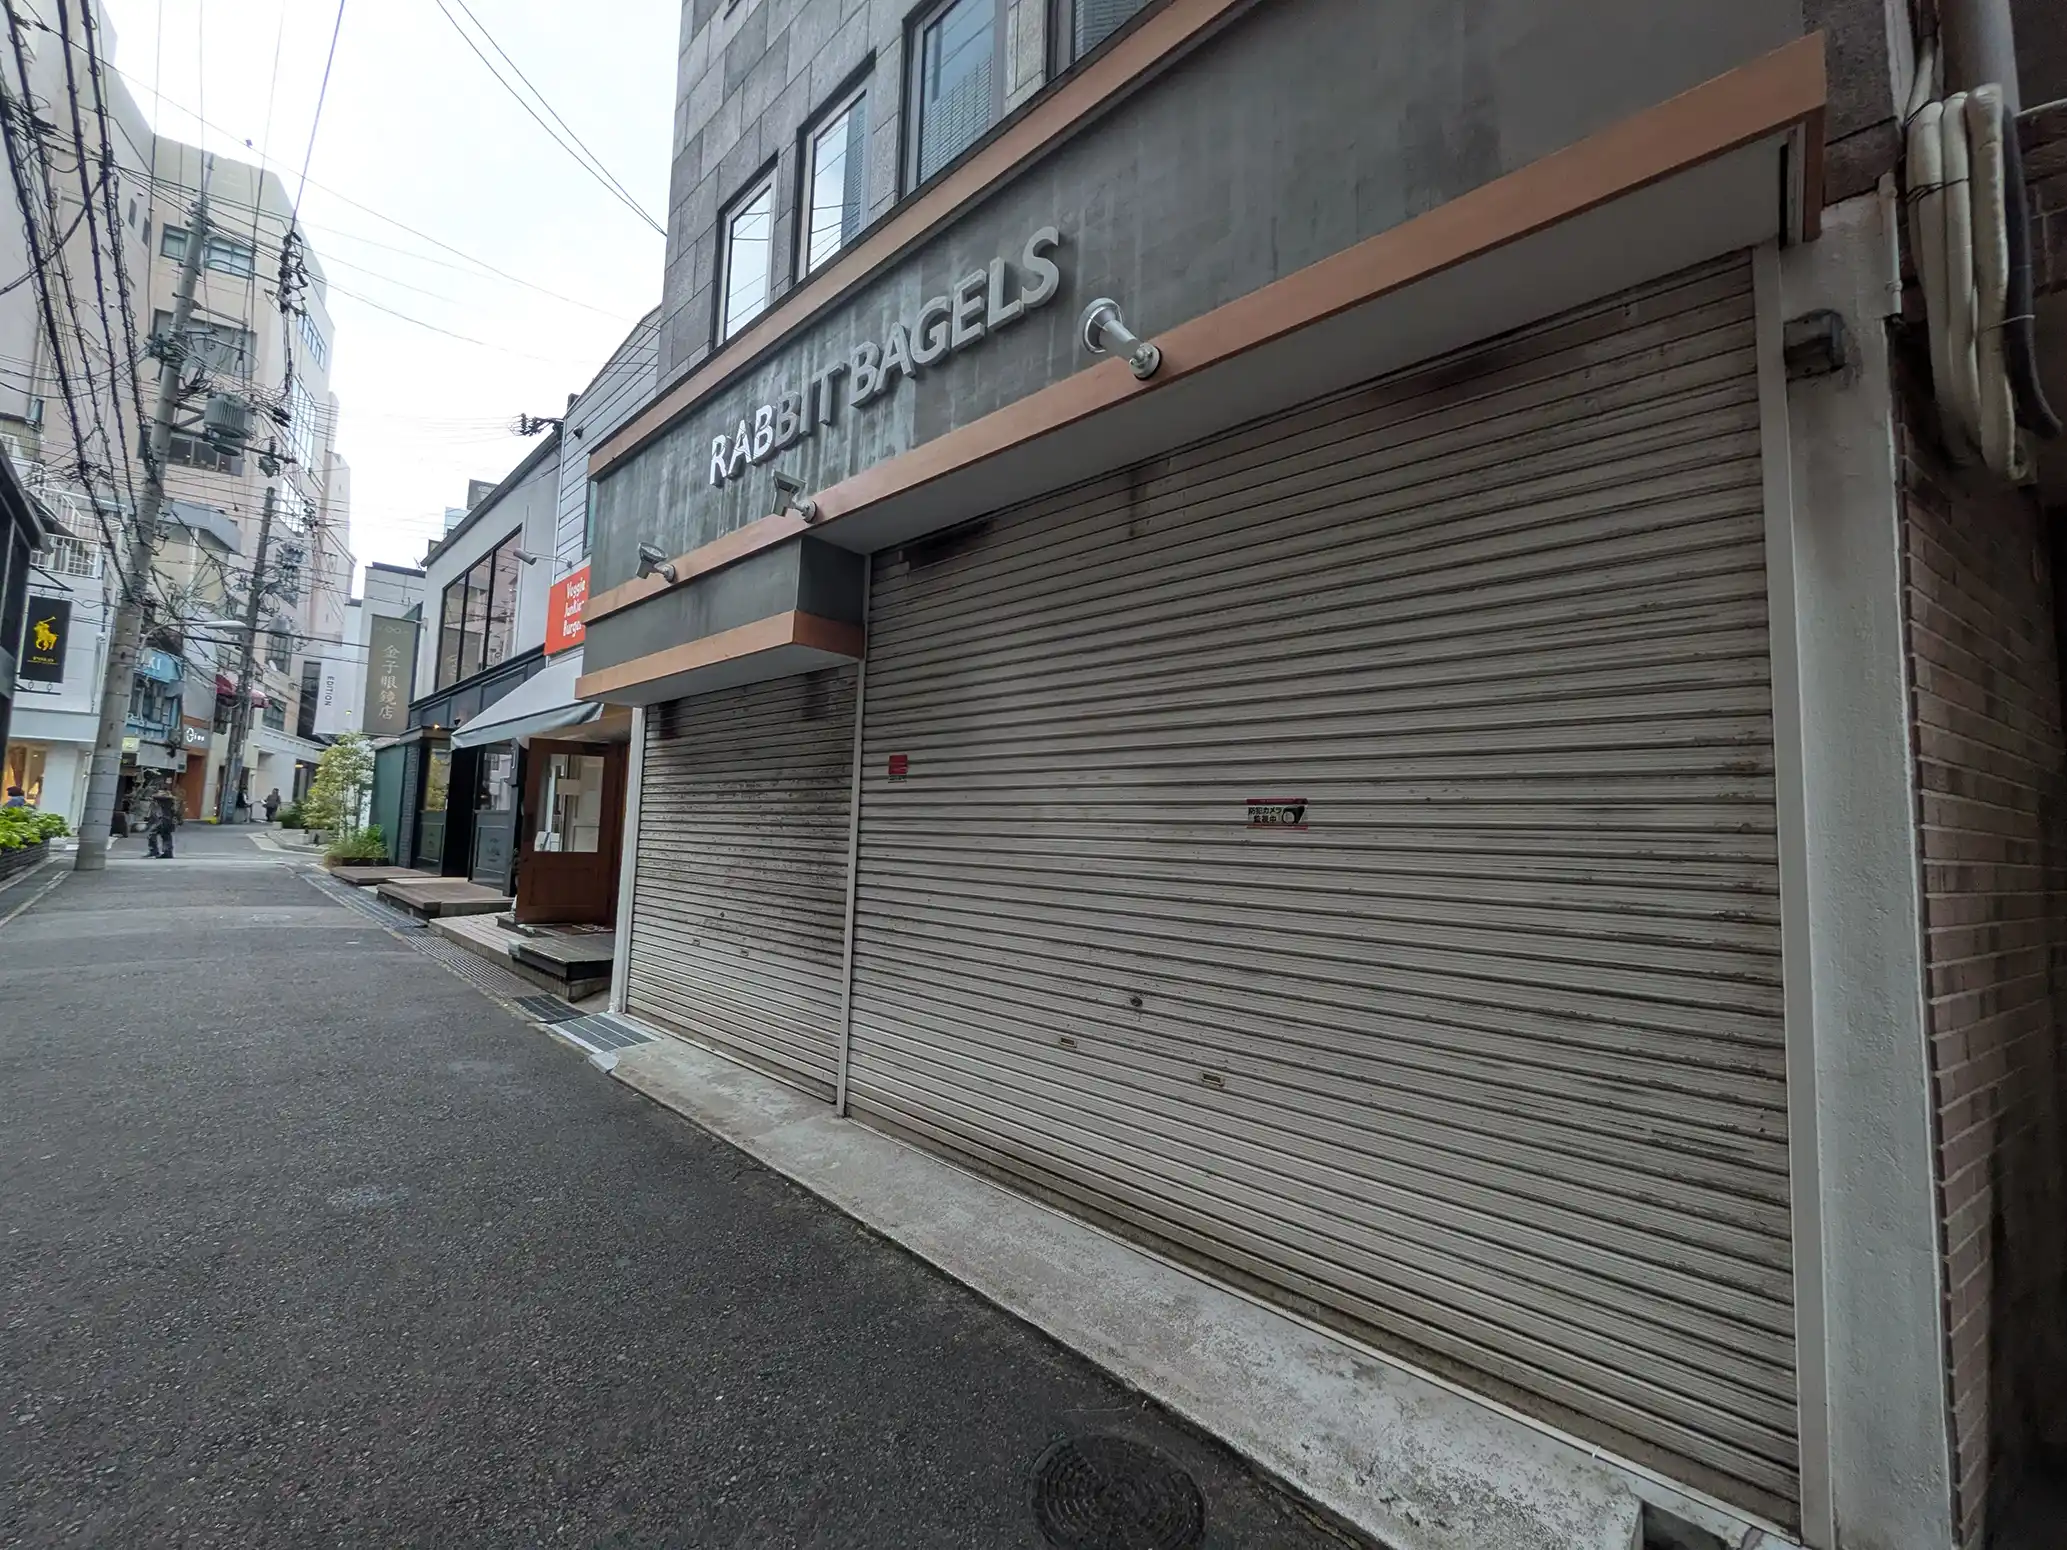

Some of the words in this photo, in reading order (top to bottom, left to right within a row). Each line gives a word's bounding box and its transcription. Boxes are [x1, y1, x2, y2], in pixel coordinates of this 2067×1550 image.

[710, 361, 848, 487] RABBIT
[850, 226, 1060, 408] BAGELS
[566, 576, 586, 599] Veggie
[324, 675, 336, 707] EDITION
[379, 644, 401, 720] 金子眼鏡店
[1248, 806, 1282, 816] 防犯カメラ
[1253, 815, 1277, 824] 監視中
